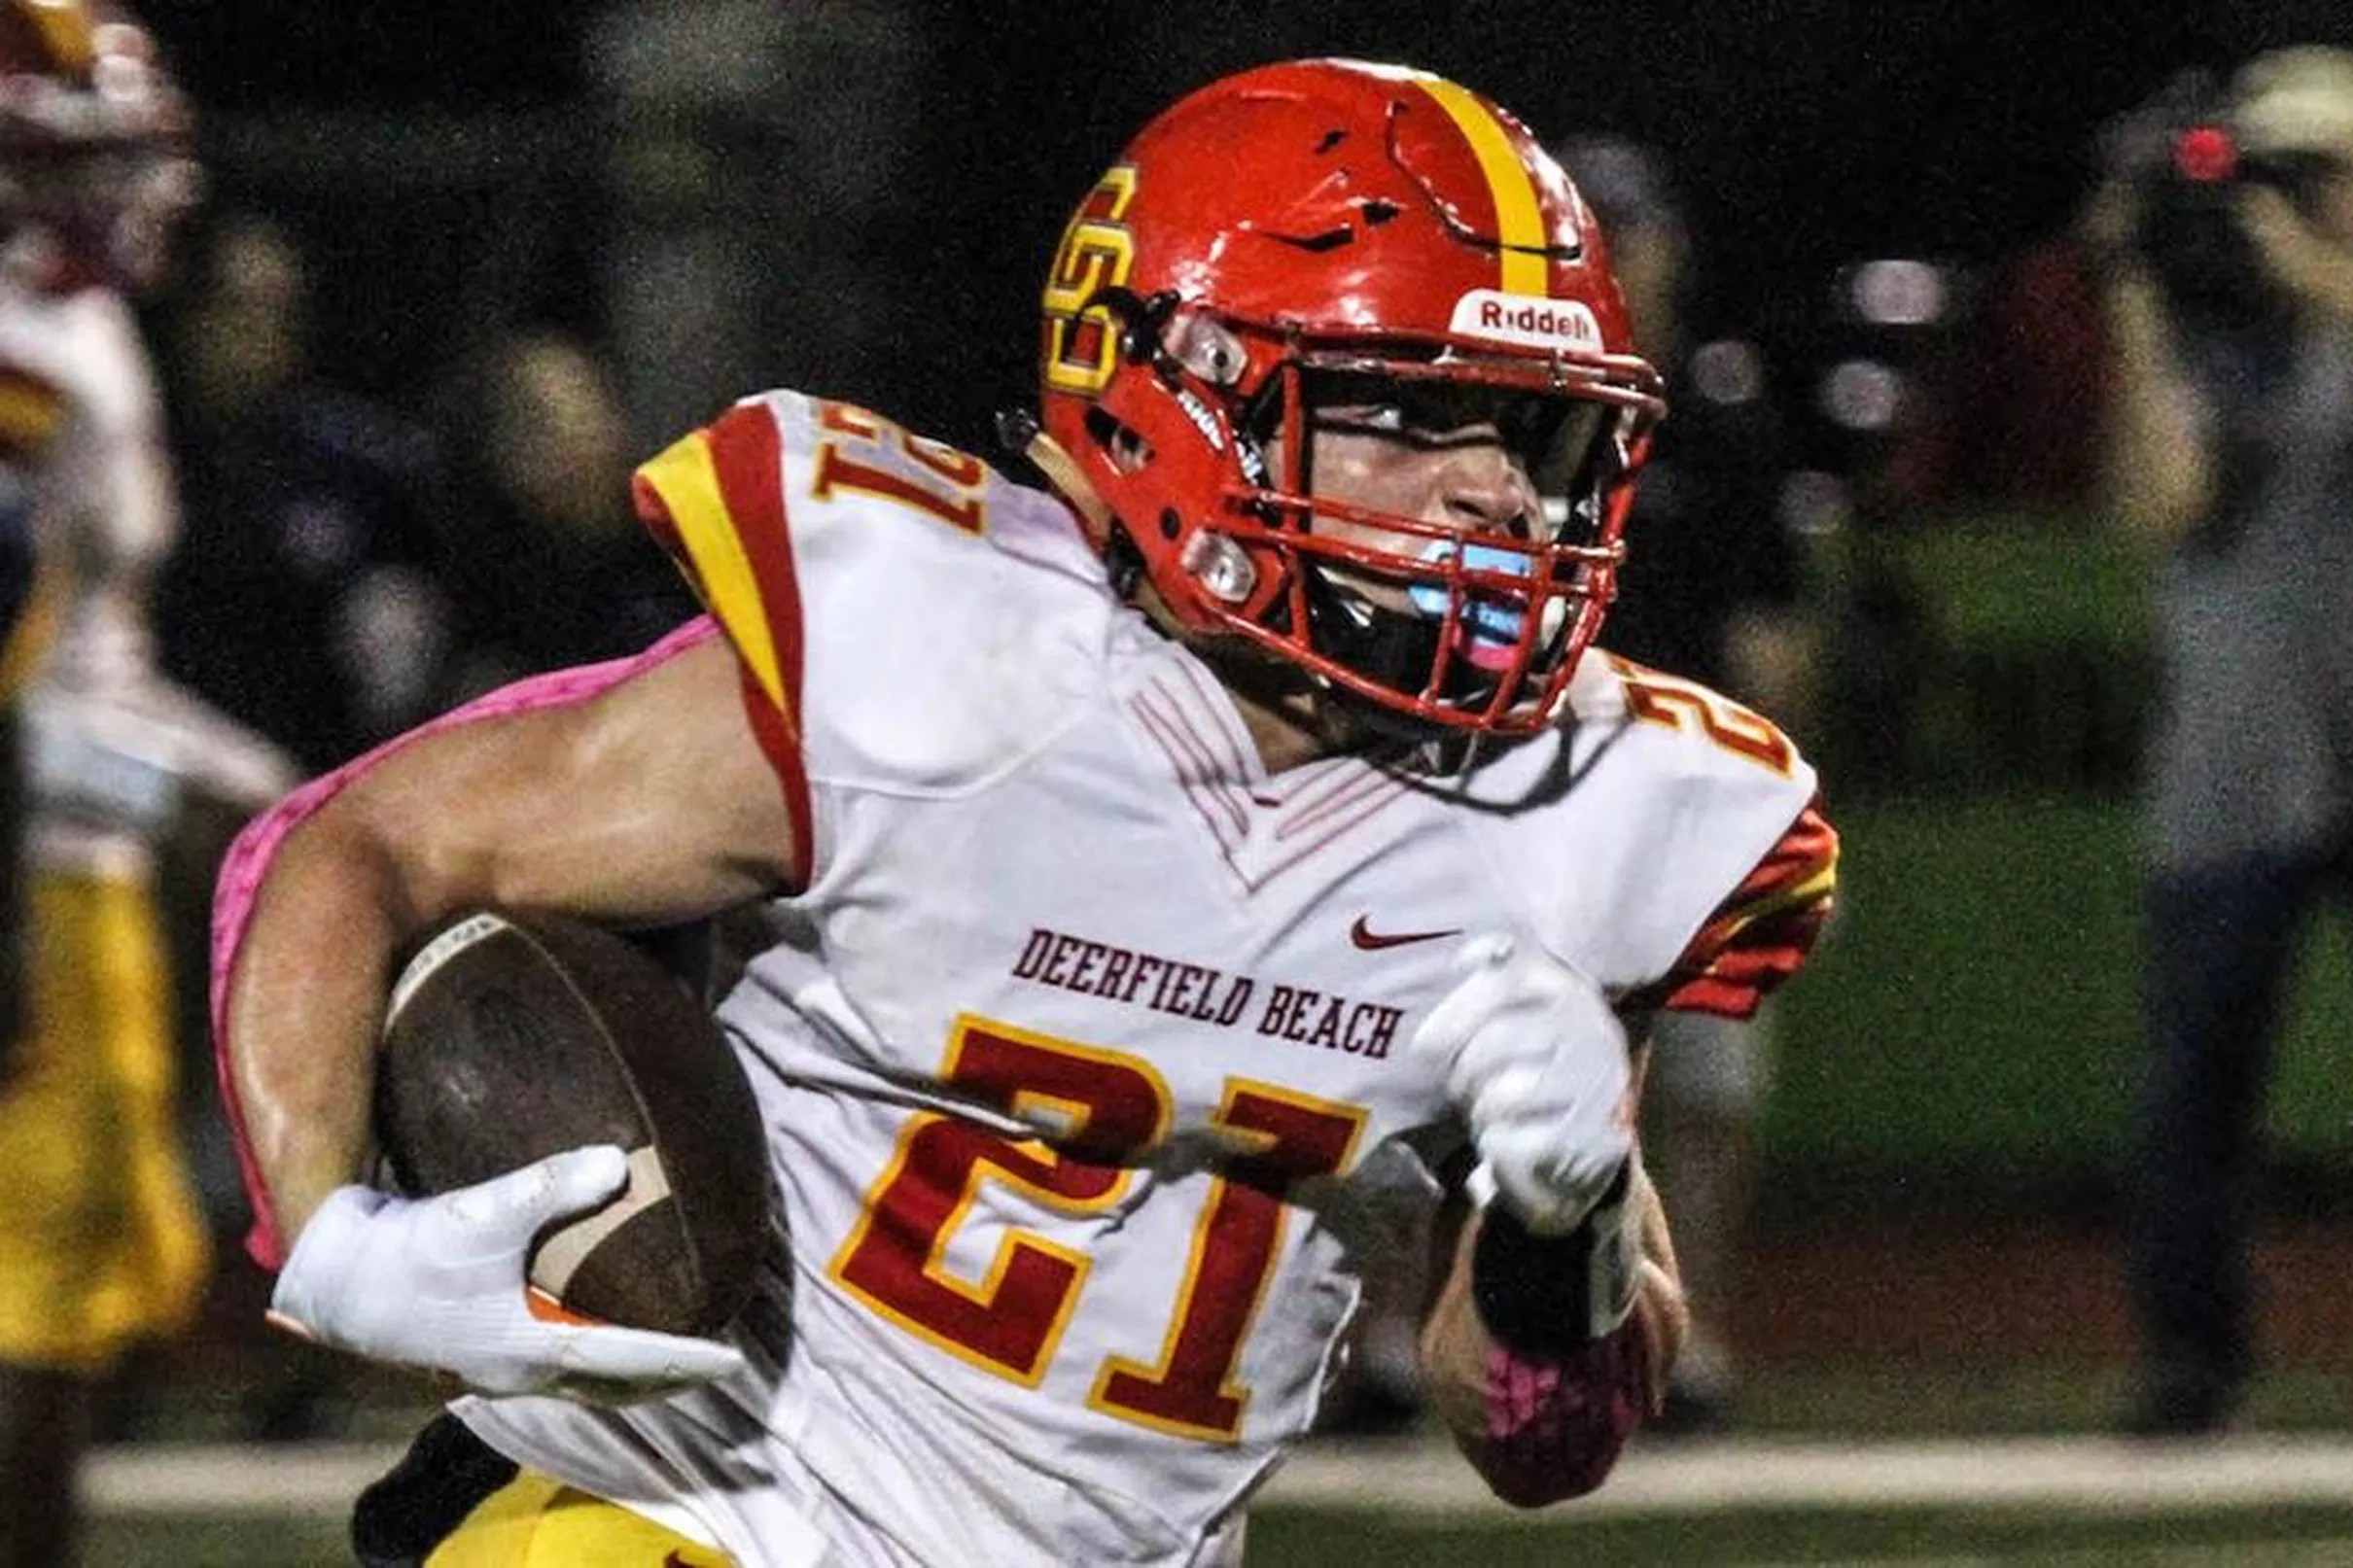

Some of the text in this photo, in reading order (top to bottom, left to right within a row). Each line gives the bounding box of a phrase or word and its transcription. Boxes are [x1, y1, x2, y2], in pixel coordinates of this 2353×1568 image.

[1606, 654, 1797, 781] 2
[1012, 928, 1406, 1060] DEERFIELD BEACH
[826, 1012, 1371, 1444] 21
